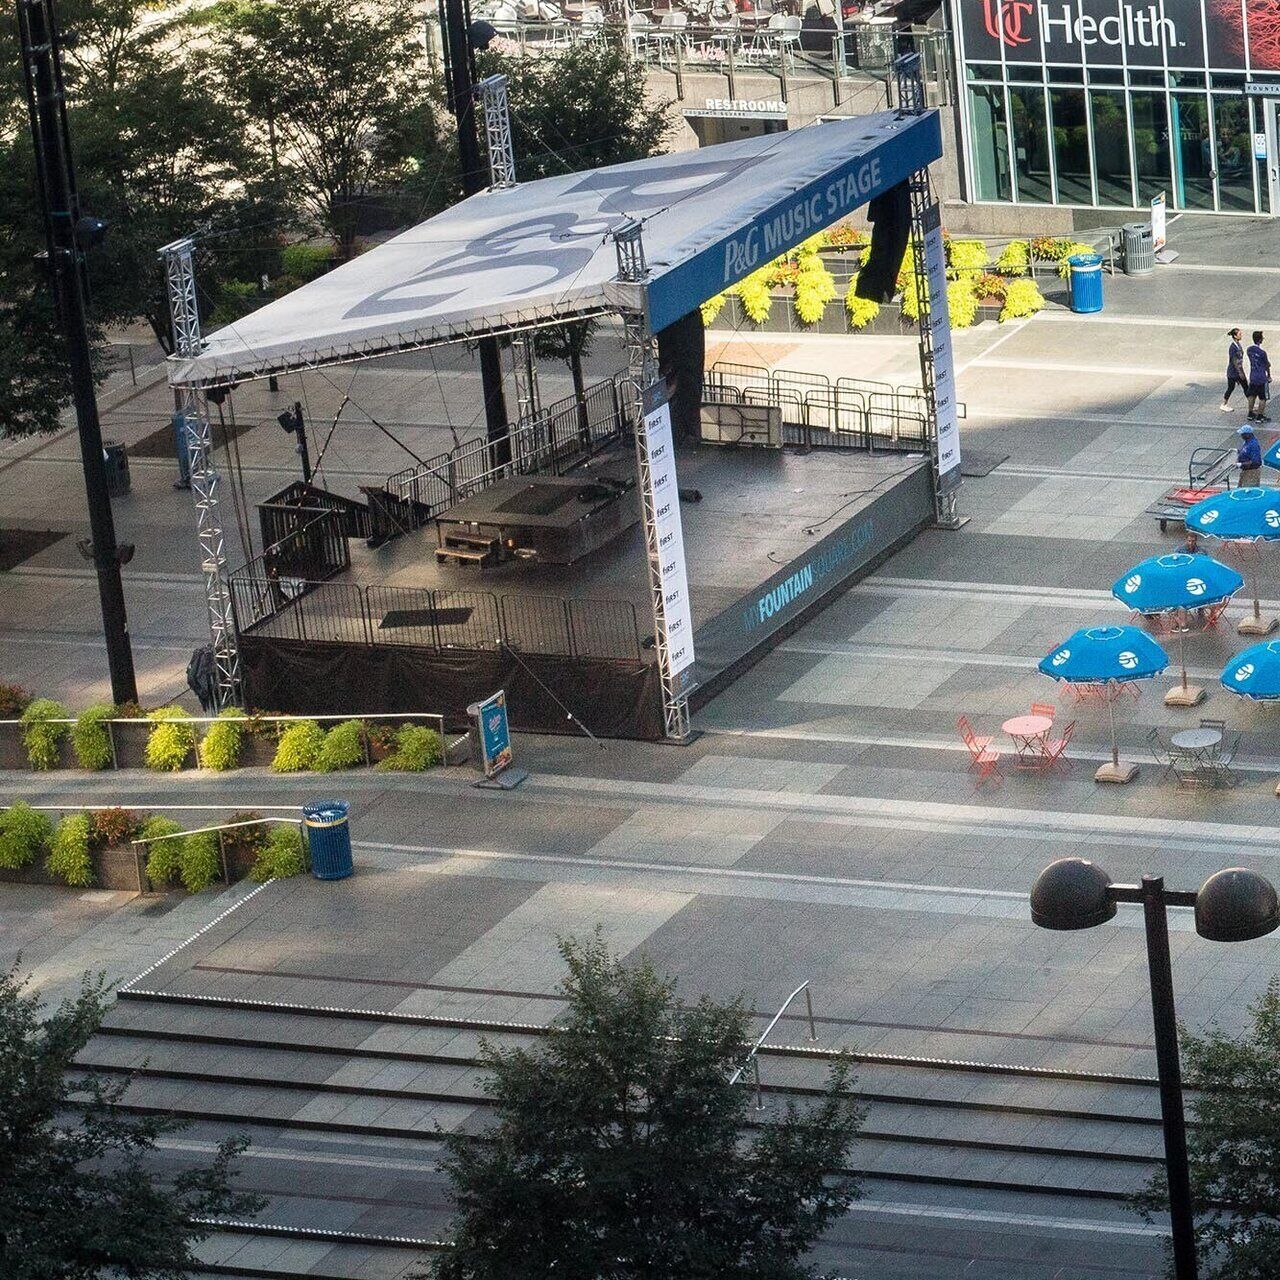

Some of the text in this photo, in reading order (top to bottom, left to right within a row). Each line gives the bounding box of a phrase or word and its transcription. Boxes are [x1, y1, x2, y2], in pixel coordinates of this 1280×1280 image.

[1042, 4, 1178, 47] Health
[705, 99, 787, 112] RESTROOMS
[723, 157, 881, 283] P&G MUSIC STAGE
